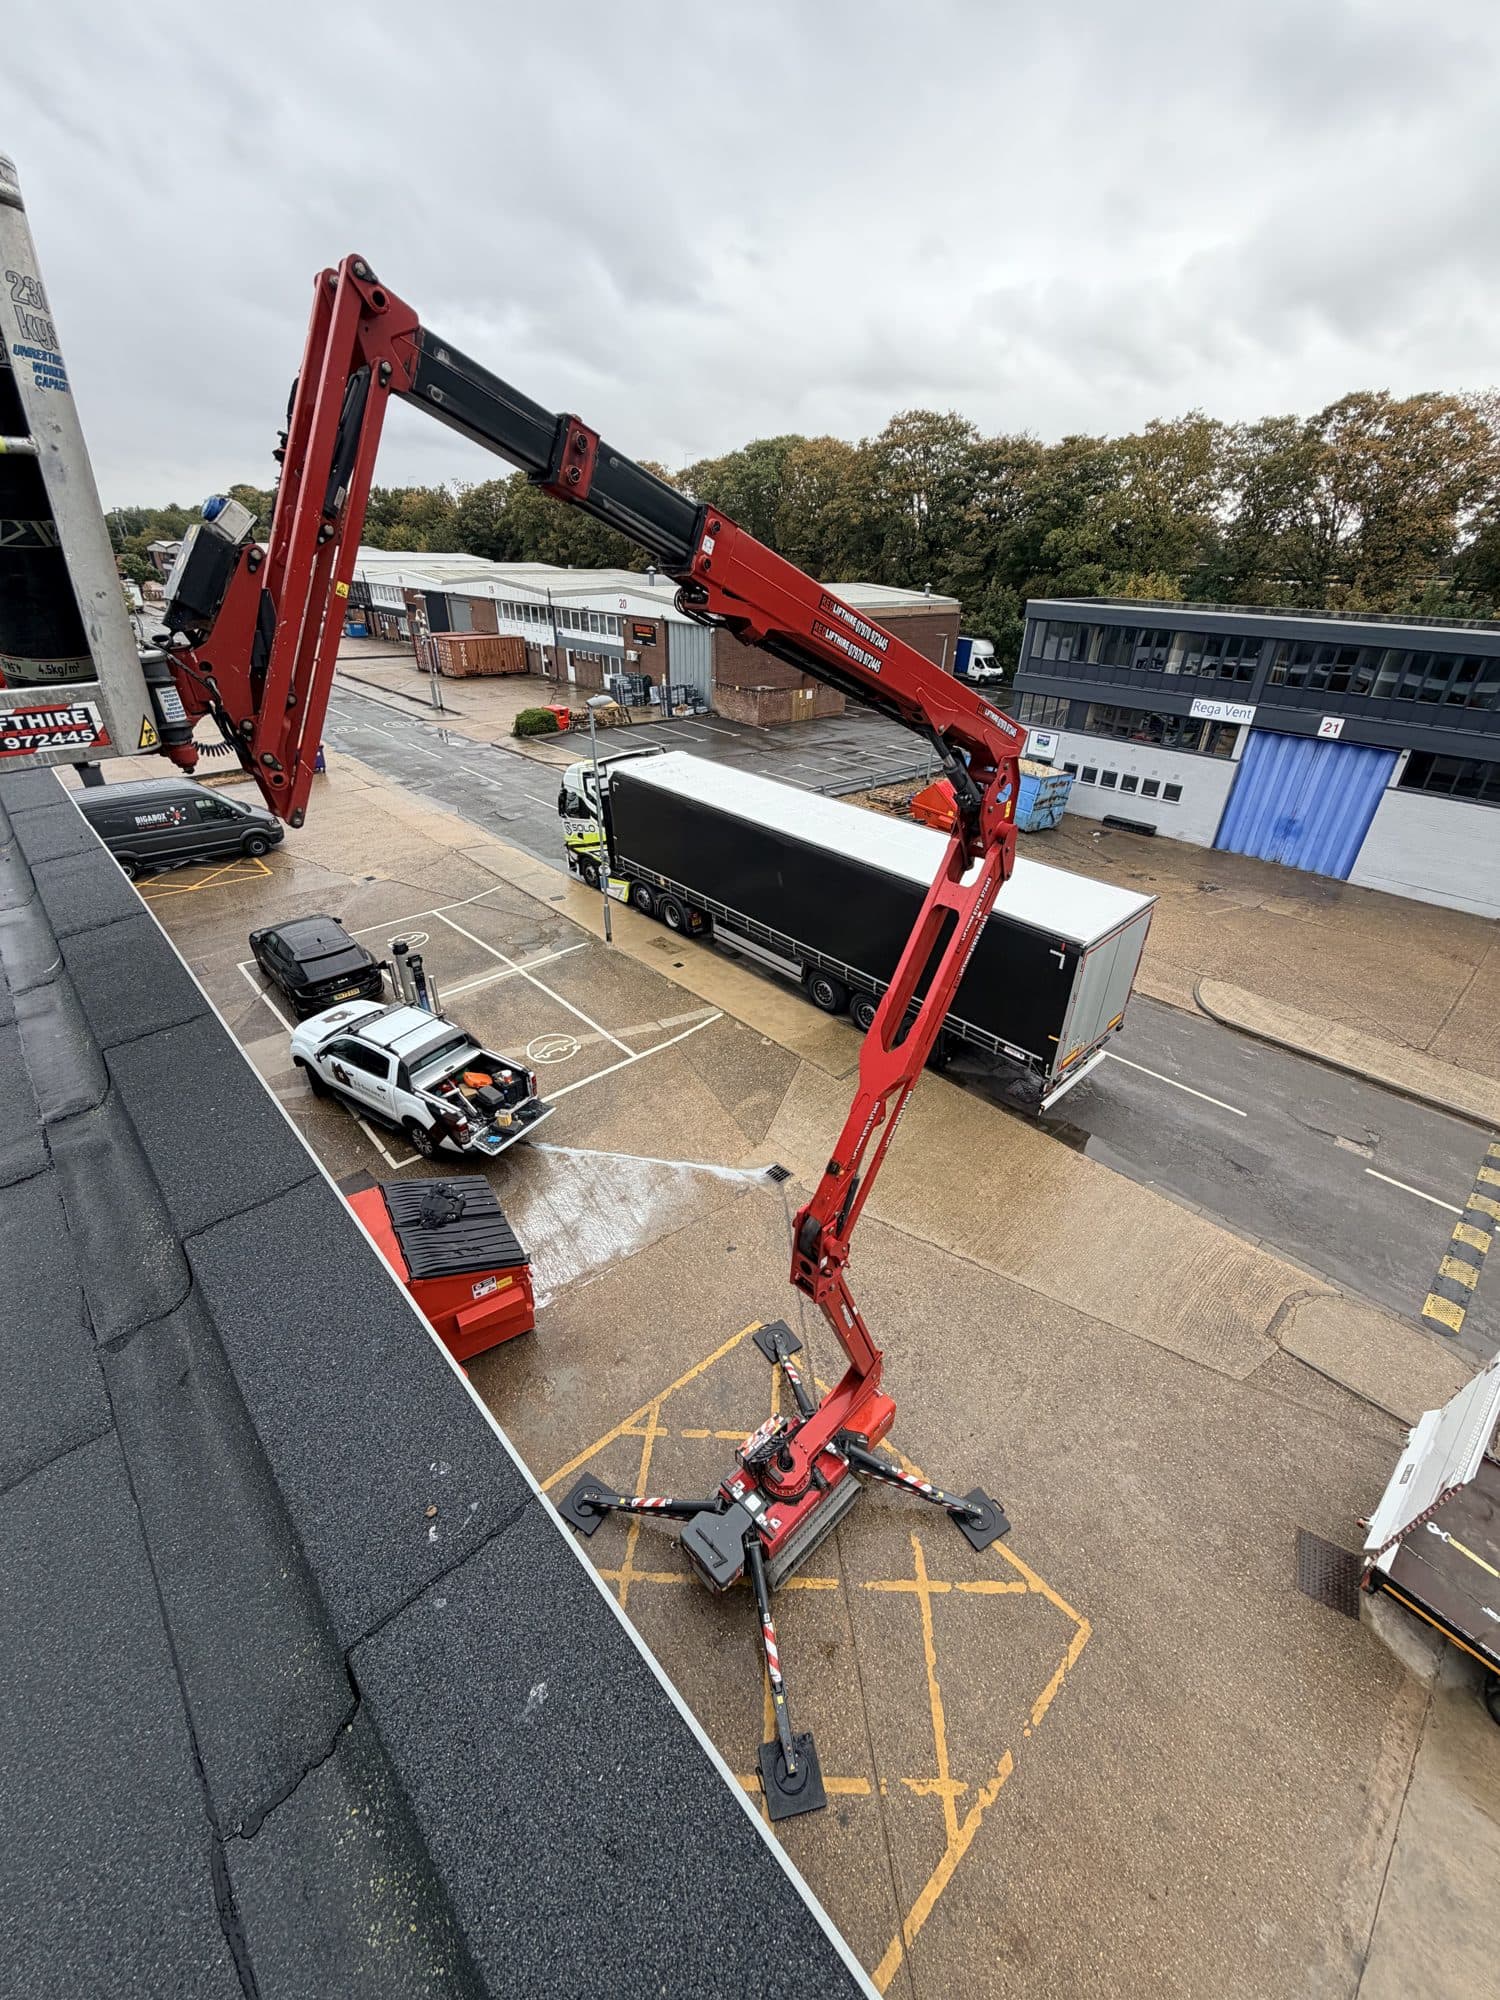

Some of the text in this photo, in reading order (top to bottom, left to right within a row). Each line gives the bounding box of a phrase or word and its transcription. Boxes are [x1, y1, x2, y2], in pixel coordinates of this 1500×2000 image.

[619, 598, 627, 609] 20
[1193, 700, 1253, 720] Rega Vent
[1323, 721, 1340, 734] 21
[4, 729, 95, 750] 972445
